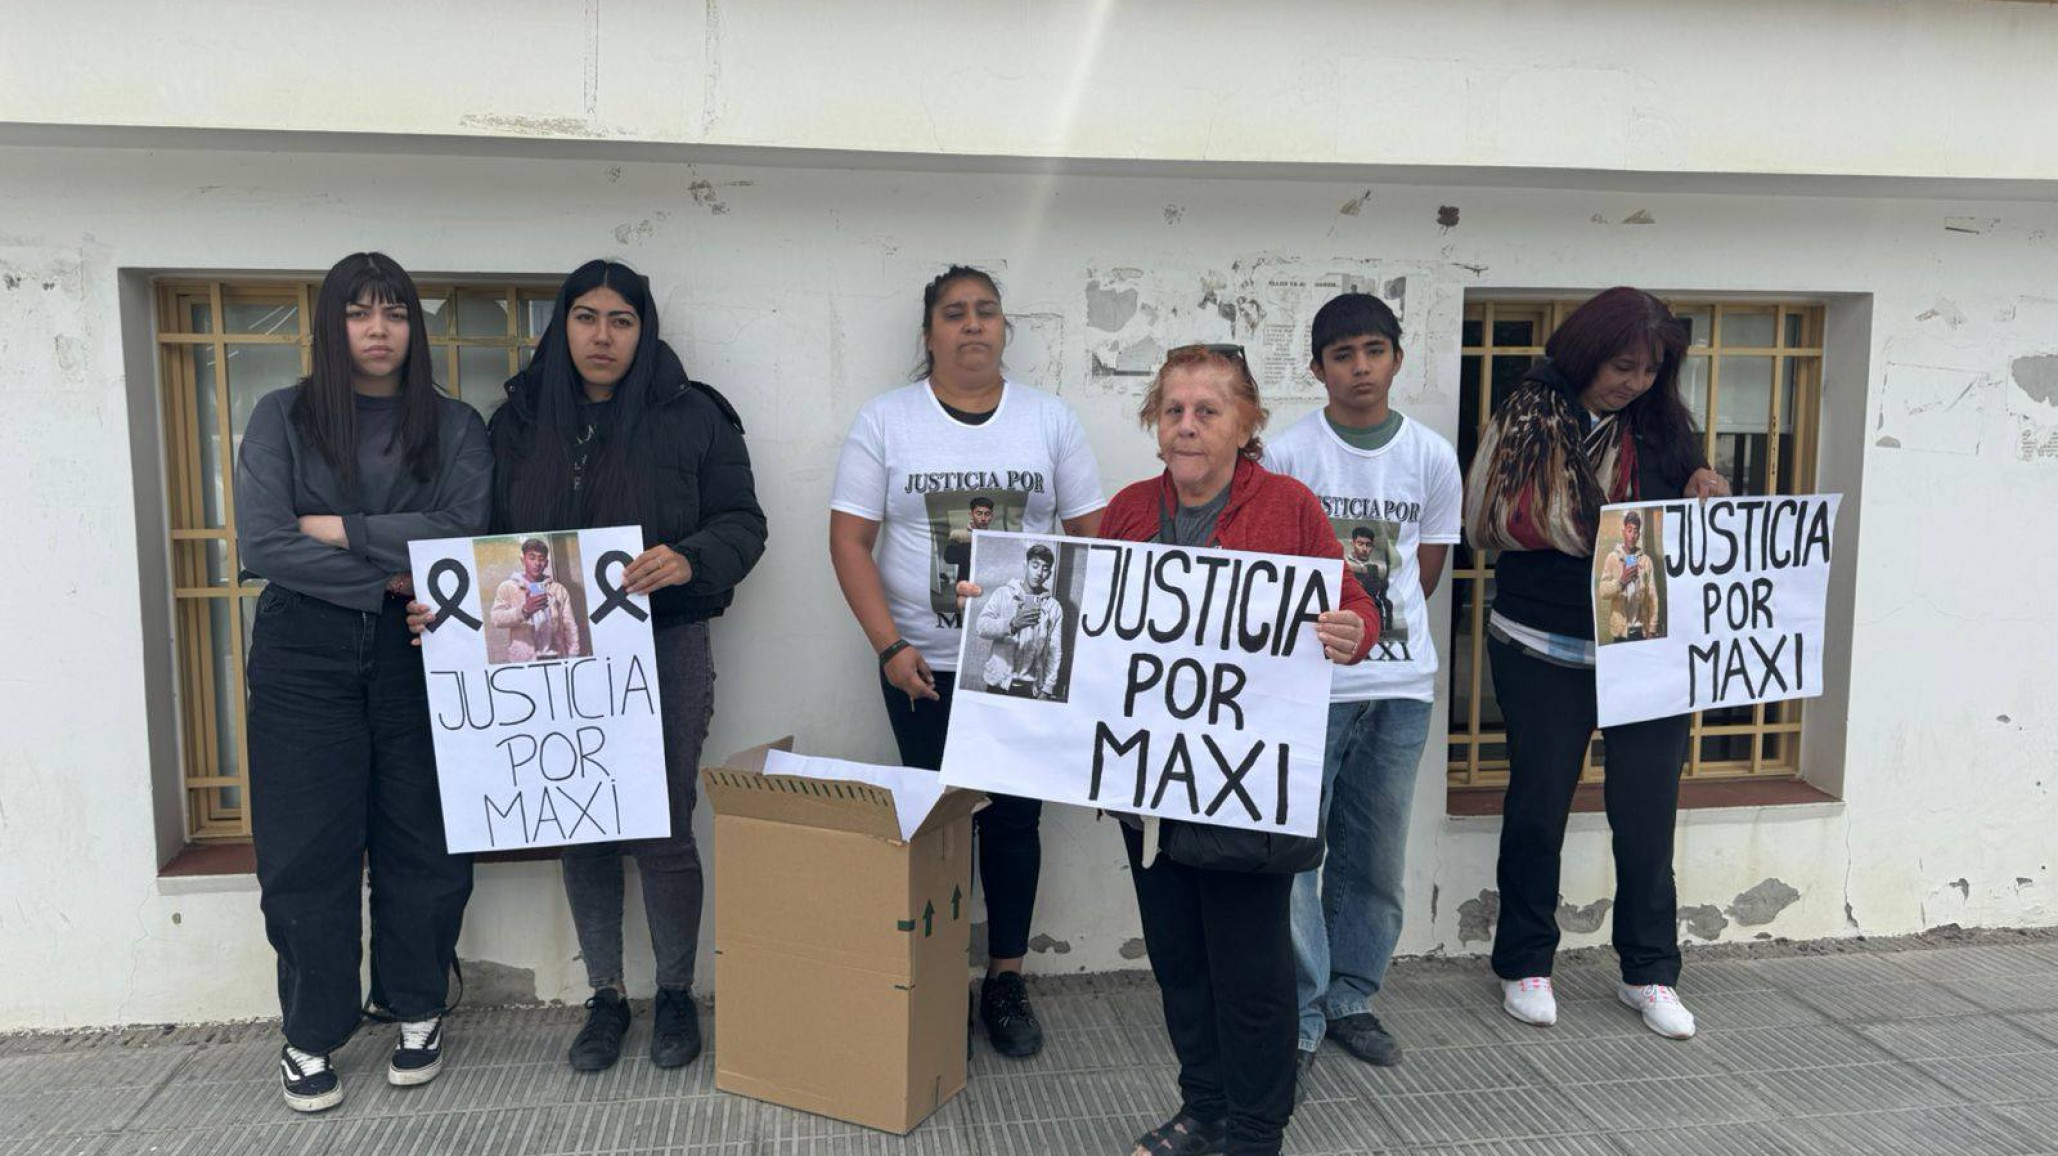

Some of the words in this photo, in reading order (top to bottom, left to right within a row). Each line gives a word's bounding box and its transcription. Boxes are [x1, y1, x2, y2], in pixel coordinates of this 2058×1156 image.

[904, 470, 1000, 494] JUSTICIA
[1007, 470, 1045, 494] POR
[1318, 495, 1381, 519] STICIA
[1384, 499, 1421, 522] POR
[1665, 499, 1831, 578] JUSTICIA
[1082, 543, 1332, 660] JUSTICIA
[1703, 577, 1774, 634] POR
[1365, 640, 1415, 661] XI
[1688, 632, 1803, 708] MAXI
[1123, 652, 1247, 731] POR
[496, 726, 611, 787] POR
[1088, 720, 1290, 826] MAXI
